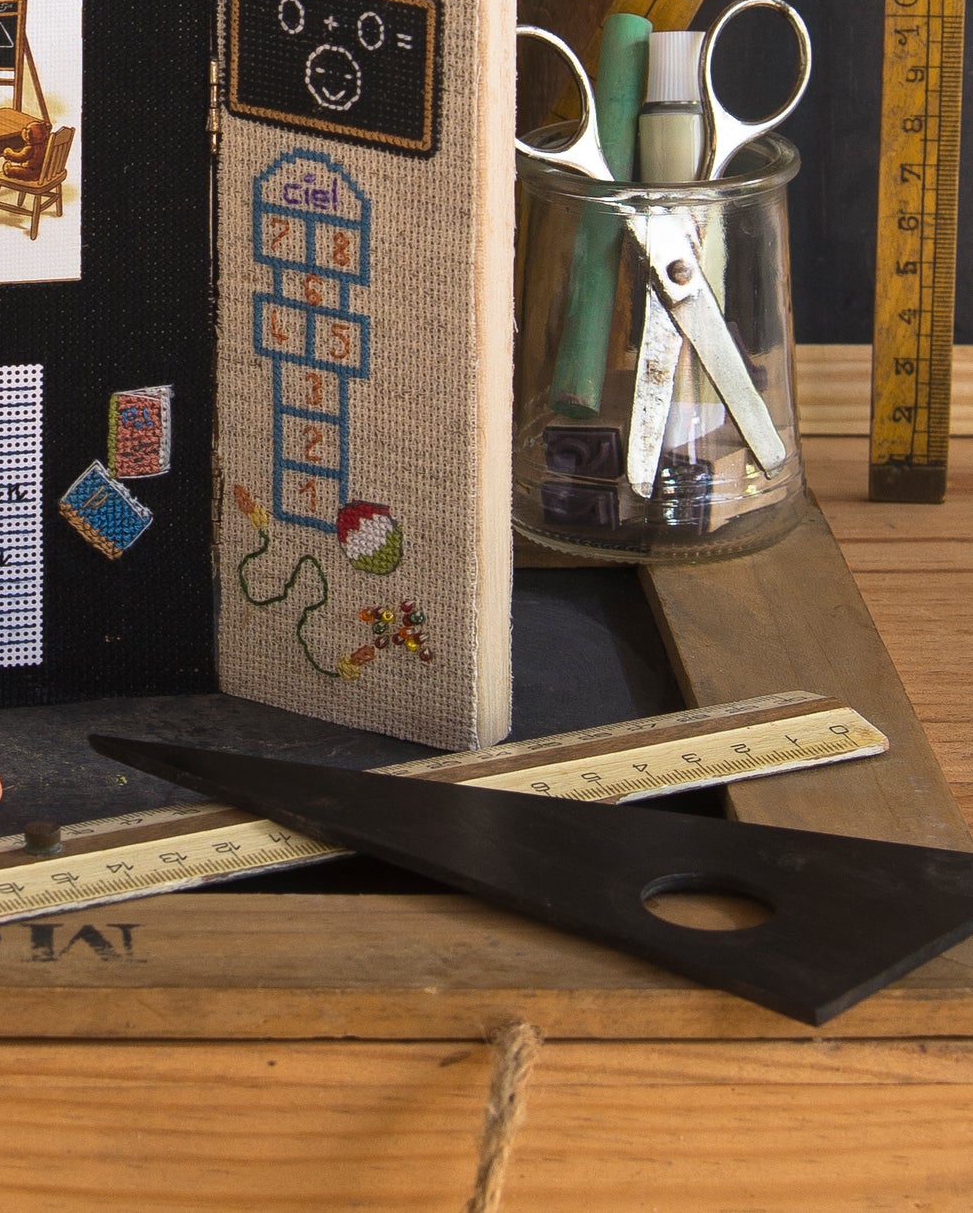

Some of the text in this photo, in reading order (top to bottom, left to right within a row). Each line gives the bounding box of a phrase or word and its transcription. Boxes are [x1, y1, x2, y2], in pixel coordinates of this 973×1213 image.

[270, 217, 350, 266] 7 8
[304, 273, 322, 306] 6
[330, 323, 350, 359] 5
[306, 372, 322, 406] 3
[304, 426, 322, 462] 2
